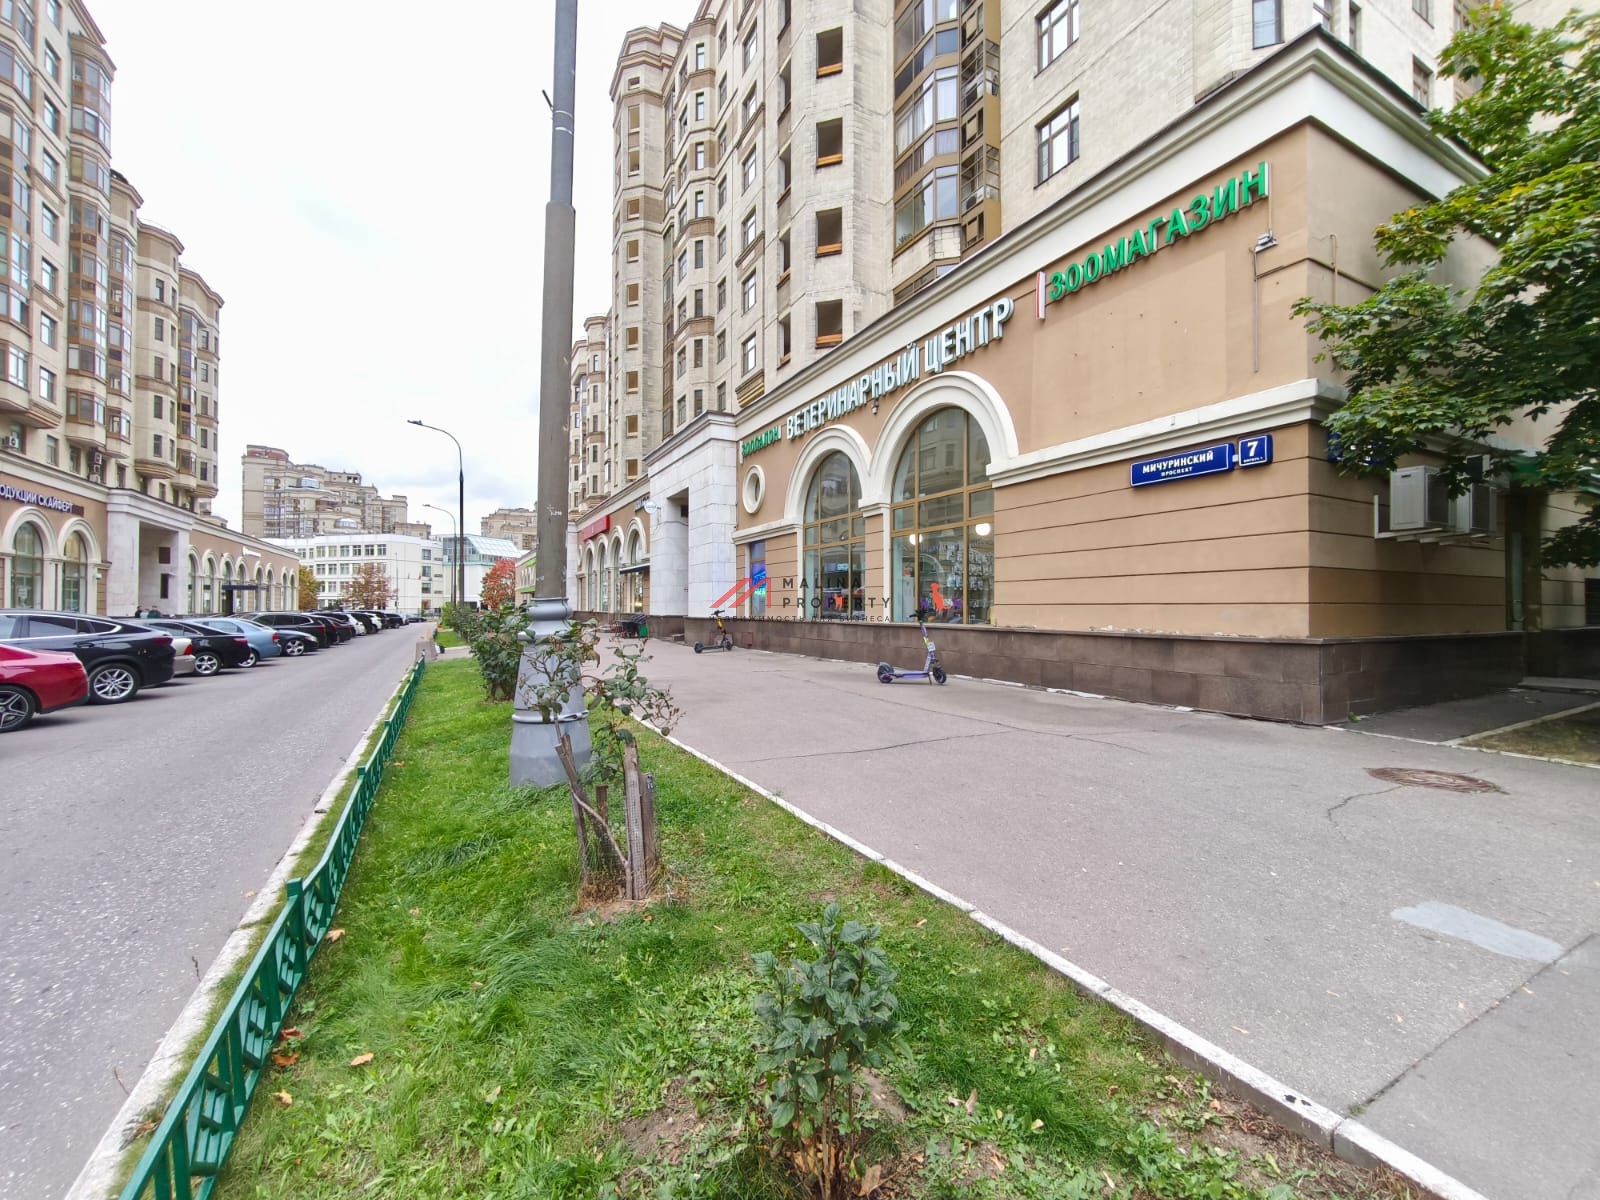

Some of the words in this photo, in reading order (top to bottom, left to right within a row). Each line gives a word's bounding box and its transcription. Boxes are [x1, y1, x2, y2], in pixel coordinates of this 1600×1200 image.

[1050, 161, 1269, 300] ЗООМАГАЗИН
[786, 342, 920, 441] ВЕТЕРИНАРНЫЙ
[924, 297, 1014, 373] ЦЕНТР
[1247, 441, 1259, 457] 7
[1142, 450, 1214, 474] МИЧУРИНСКИЙ
[1161, 466, 1193, 477] ПРОСПЕКТ
[38, 495, 73, 513] СКАЙФЕРТ
